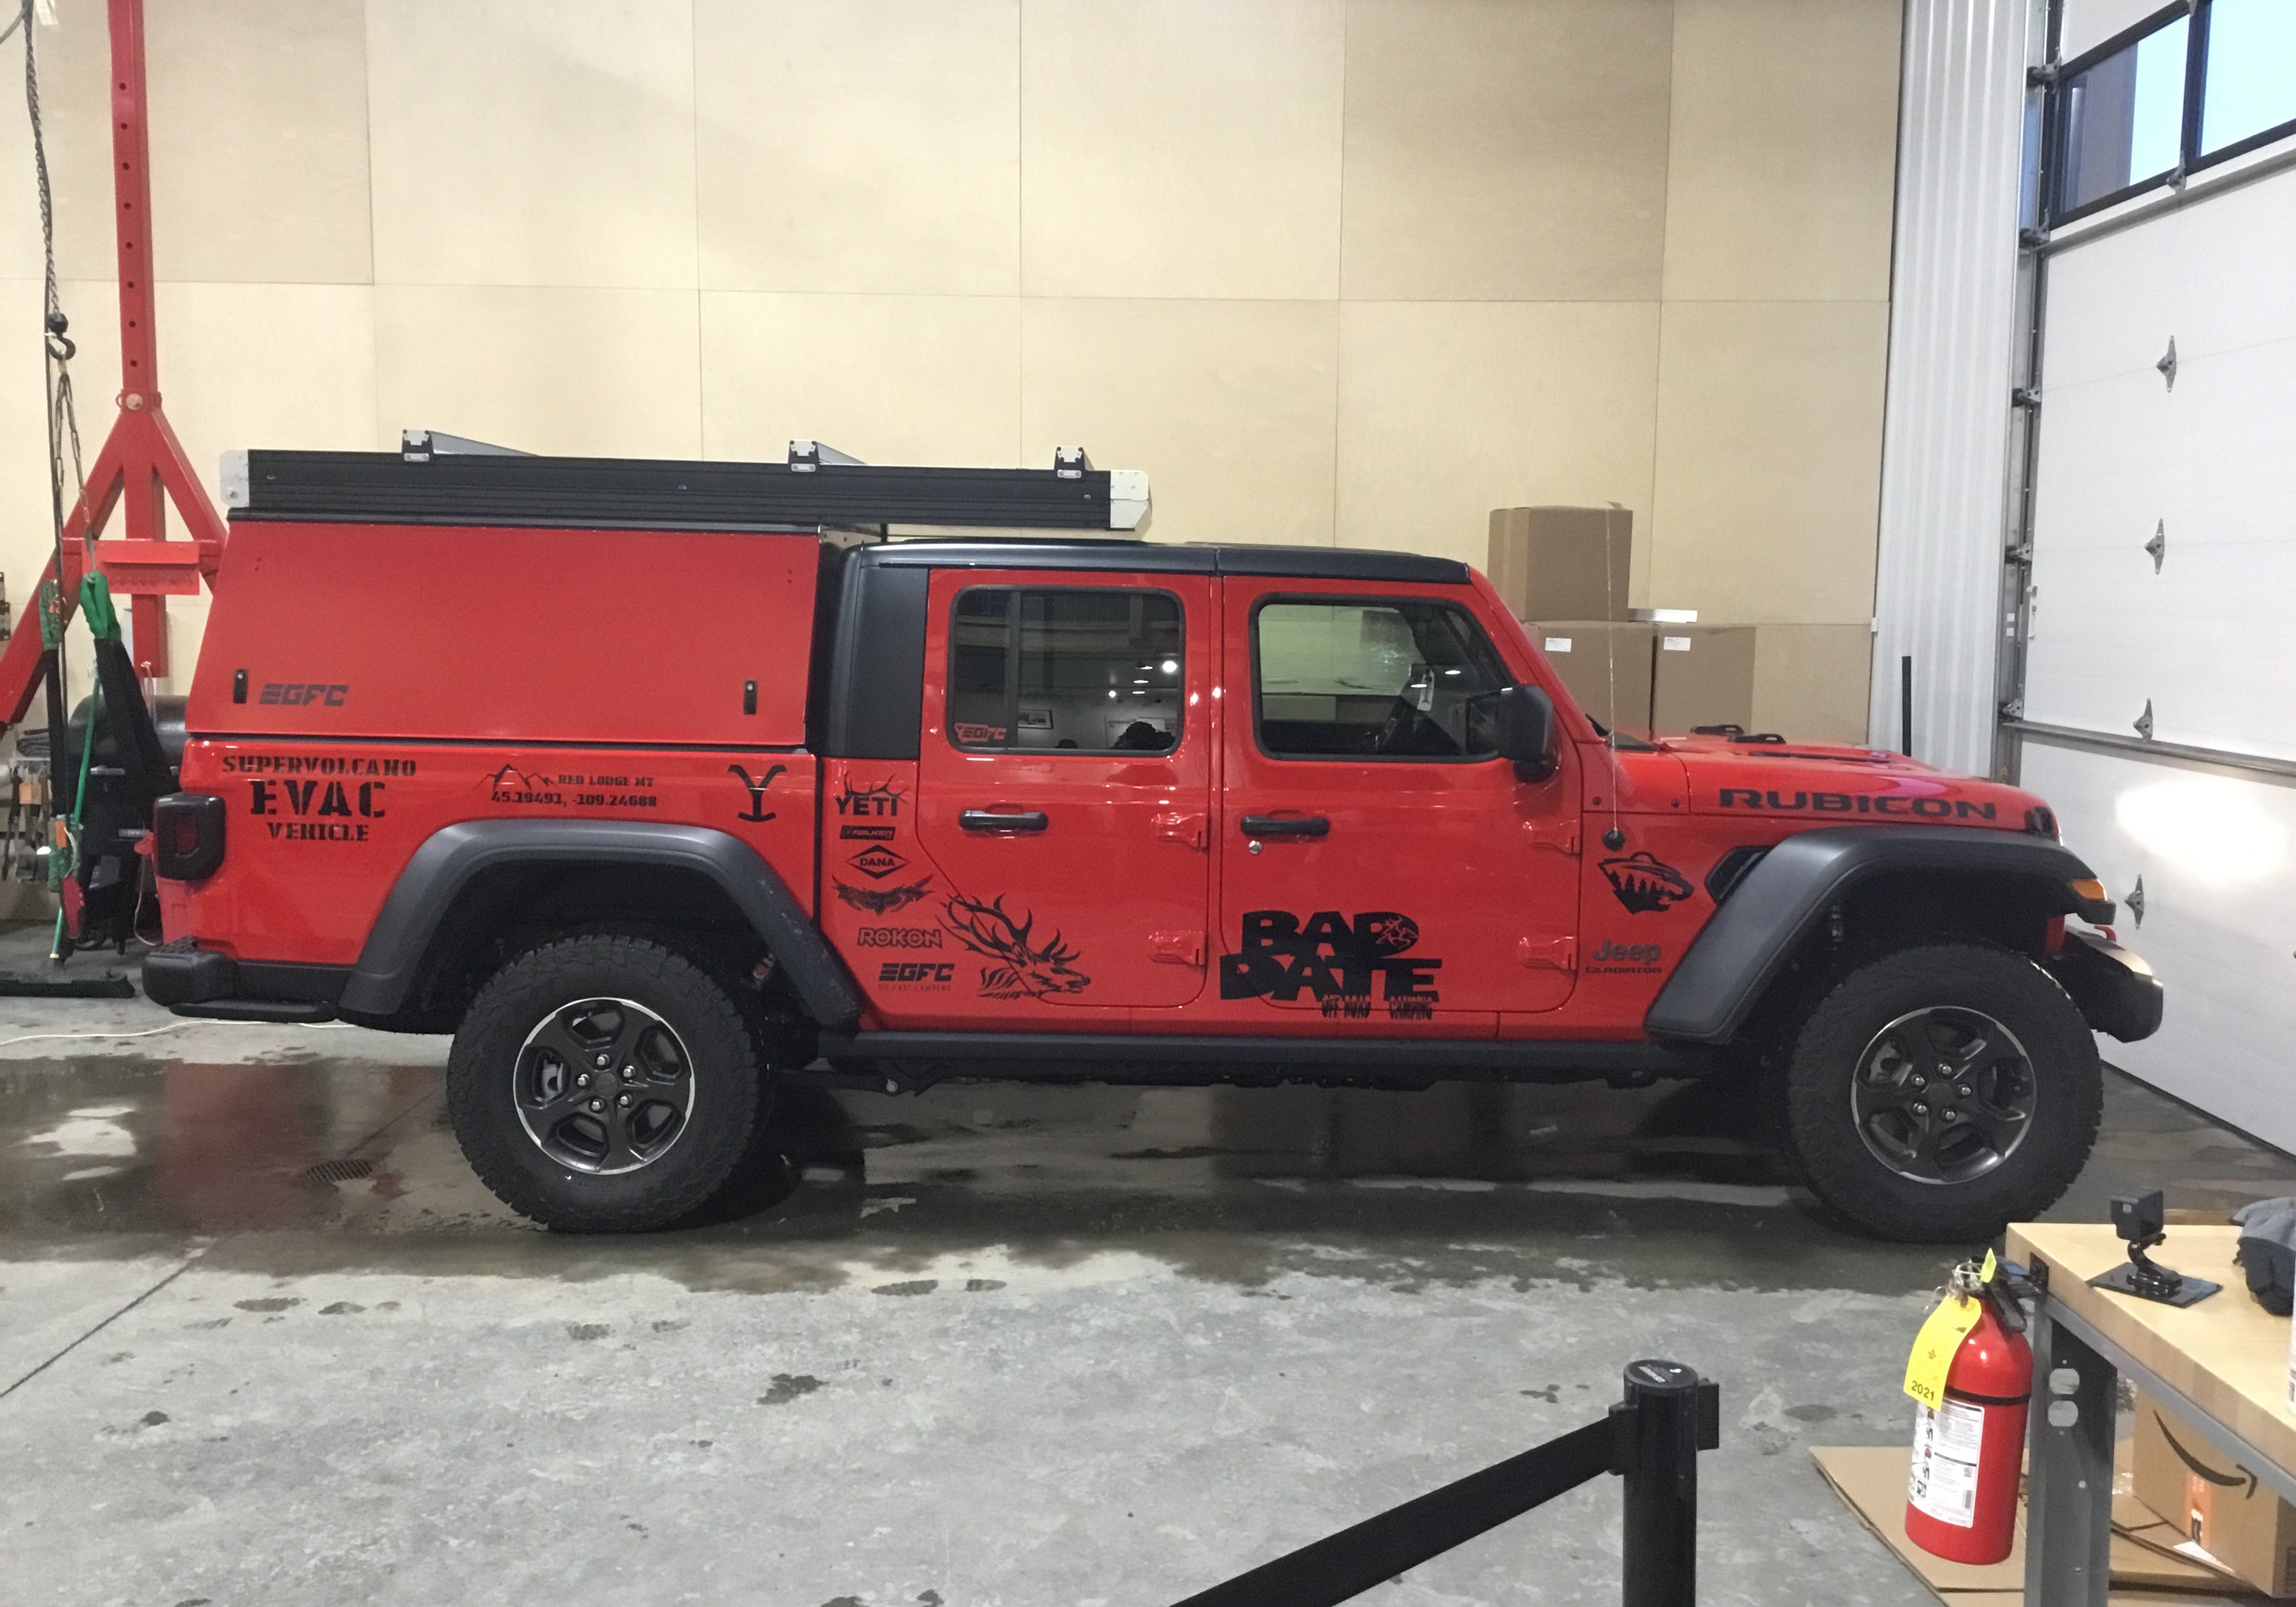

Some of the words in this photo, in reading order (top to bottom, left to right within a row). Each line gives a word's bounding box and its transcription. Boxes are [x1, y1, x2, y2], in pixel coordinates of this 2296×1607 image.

[222, 755, 416, 777] SUPERVOLCANO
[558, 775, 585, 785] RED
[589, 775, 630, 787] LODGE
[634, 777, 655, 787] MT
[250, 779, 385, 818] EVAC
[835, 796, 898, 816] YETI
[1719, 788, 1996, 820] RUBICON
[267, 822, 369, 841] VEHICLE
[860, 858, 895, 867] DANA
[857, 927, 943, 948] ROKON
[1242, 910, 1419, 957] BAD
[1593, 939, 1662, 965] Jeep
[1219, 953, 1442, 1002] DATE
[1911, 1380, 1935, 1402] 2021
